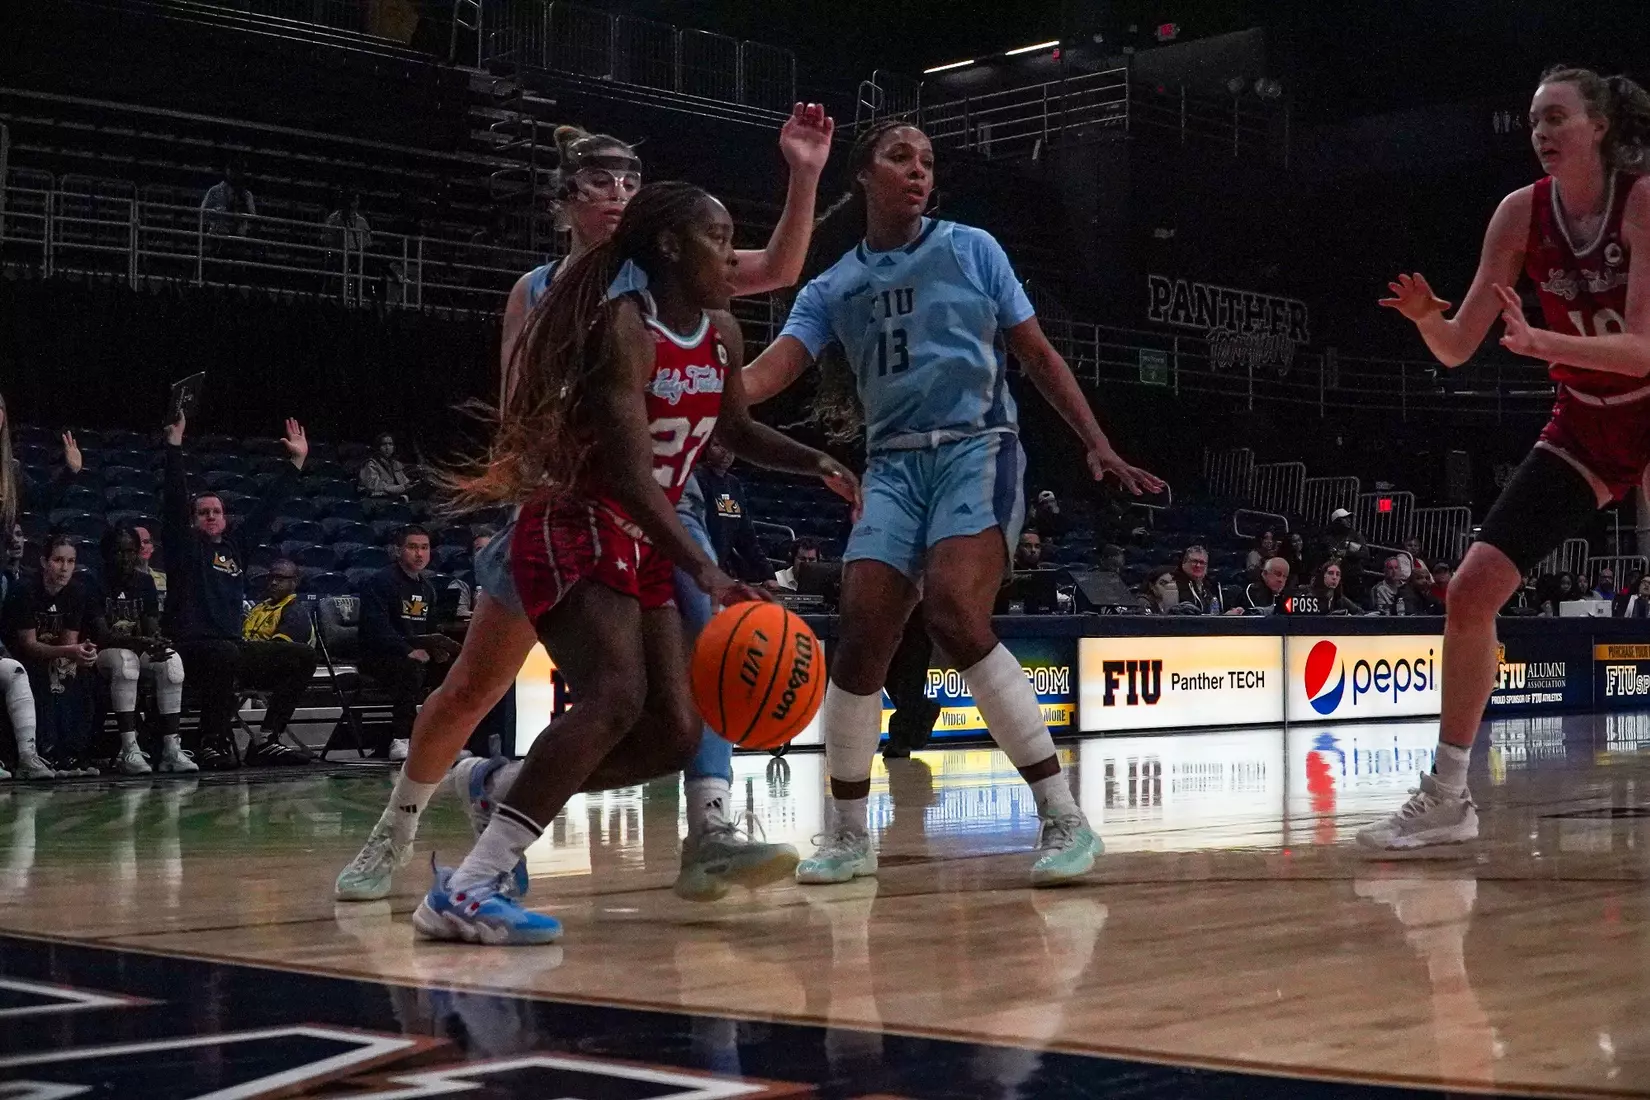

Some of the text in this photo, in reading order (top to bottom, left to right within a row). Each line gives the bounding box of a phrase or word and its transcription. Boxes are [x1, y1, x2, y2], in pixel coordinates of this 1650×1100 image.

[1148, 274, 1311, 344] PANTHER
[878, 328, 909, 377] 13
[649, 416, 718, 488] 27
[771, 631, 813, 721] Wilson
[1102, 659, 1265, 707] FIU Panther TECH
[1353, 648, 1434, 706] pepsi
[1491, 695, 1506, 705] PROUD
[1506, 694, 1525, 704] SPONSOR
[1531, 692, 1543, 704] FIU
[1499, 661, 1566, 689] FIU ALUMNI
[1527, 679, 1566, 689] ASSOCIATION
